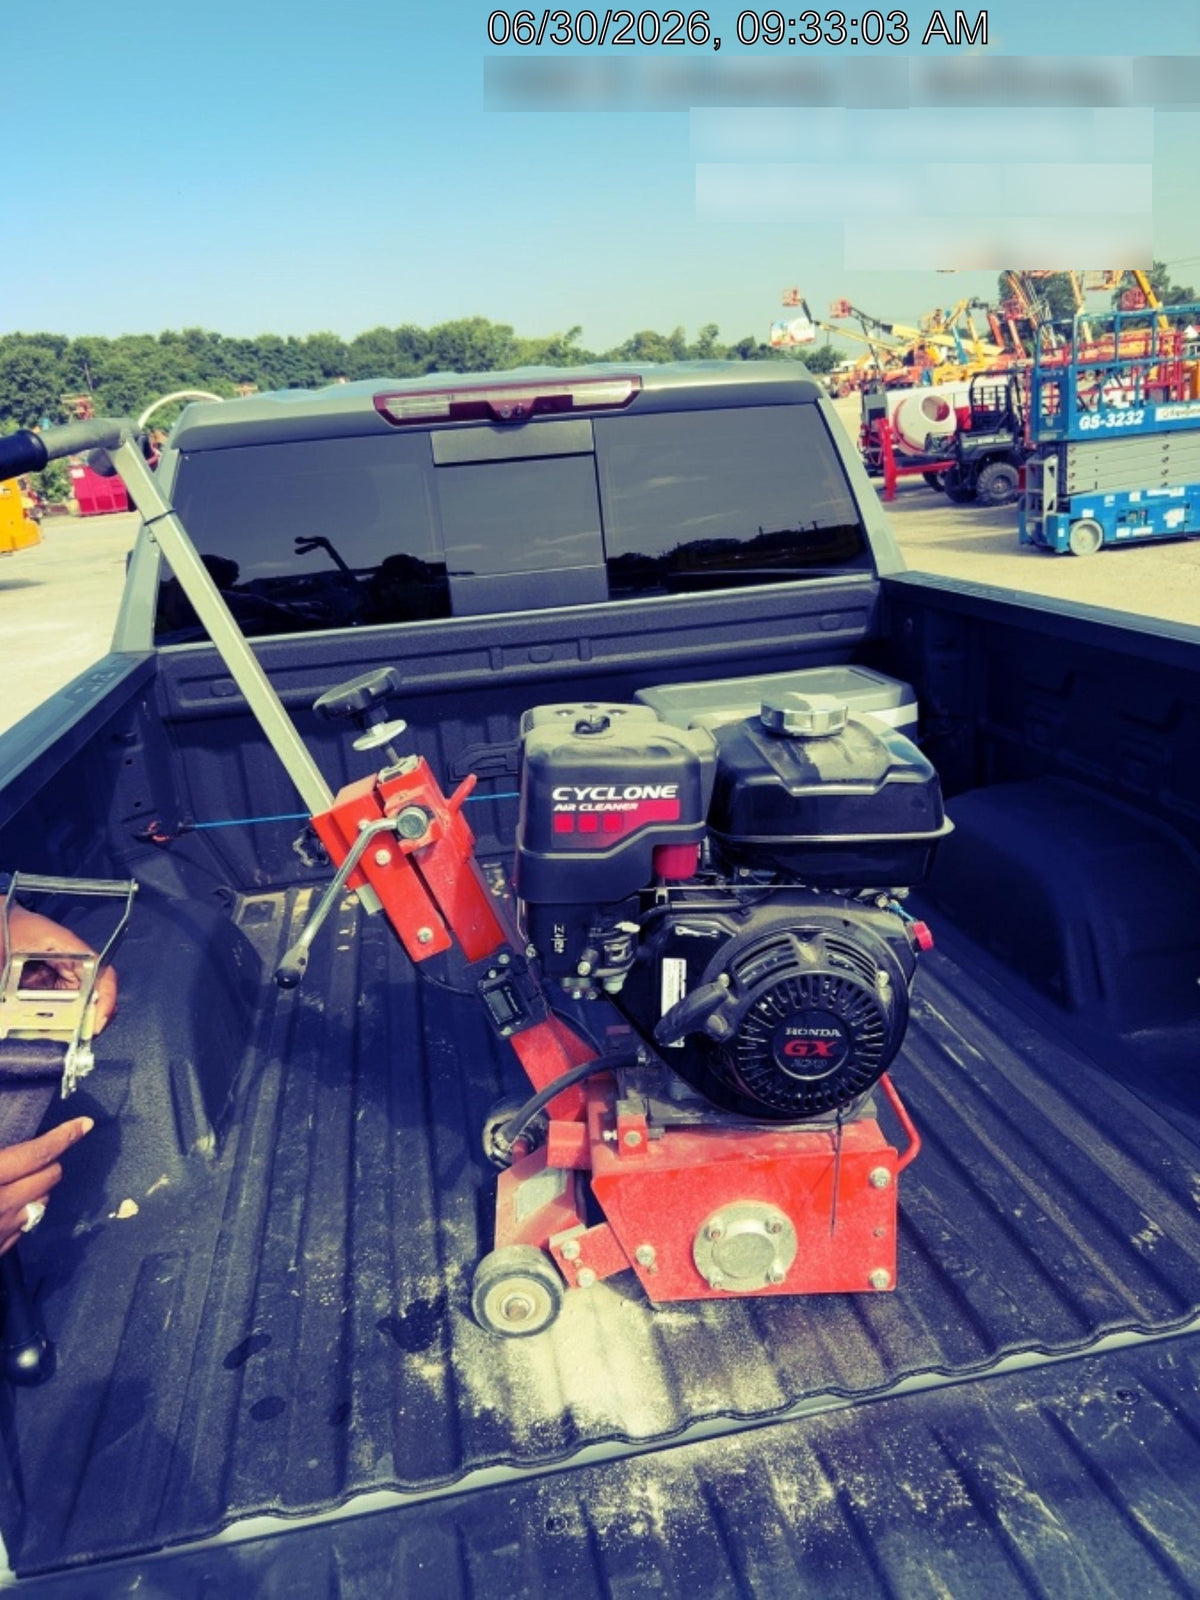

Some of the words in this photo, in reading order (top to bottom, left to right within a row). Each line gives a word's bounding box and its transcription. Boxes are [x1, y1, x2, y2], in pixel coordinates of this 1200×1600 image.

[1079, 409, 1145, 431] GS-3232
[552, 785, 678, 801] CYCLONE
[553, 803, 577, 812] AIR
[578, 802, 639, 812] CLEANER
[785, 1027, 842, 1038] HONDA
[784, 1040, 838, 1057] GX
